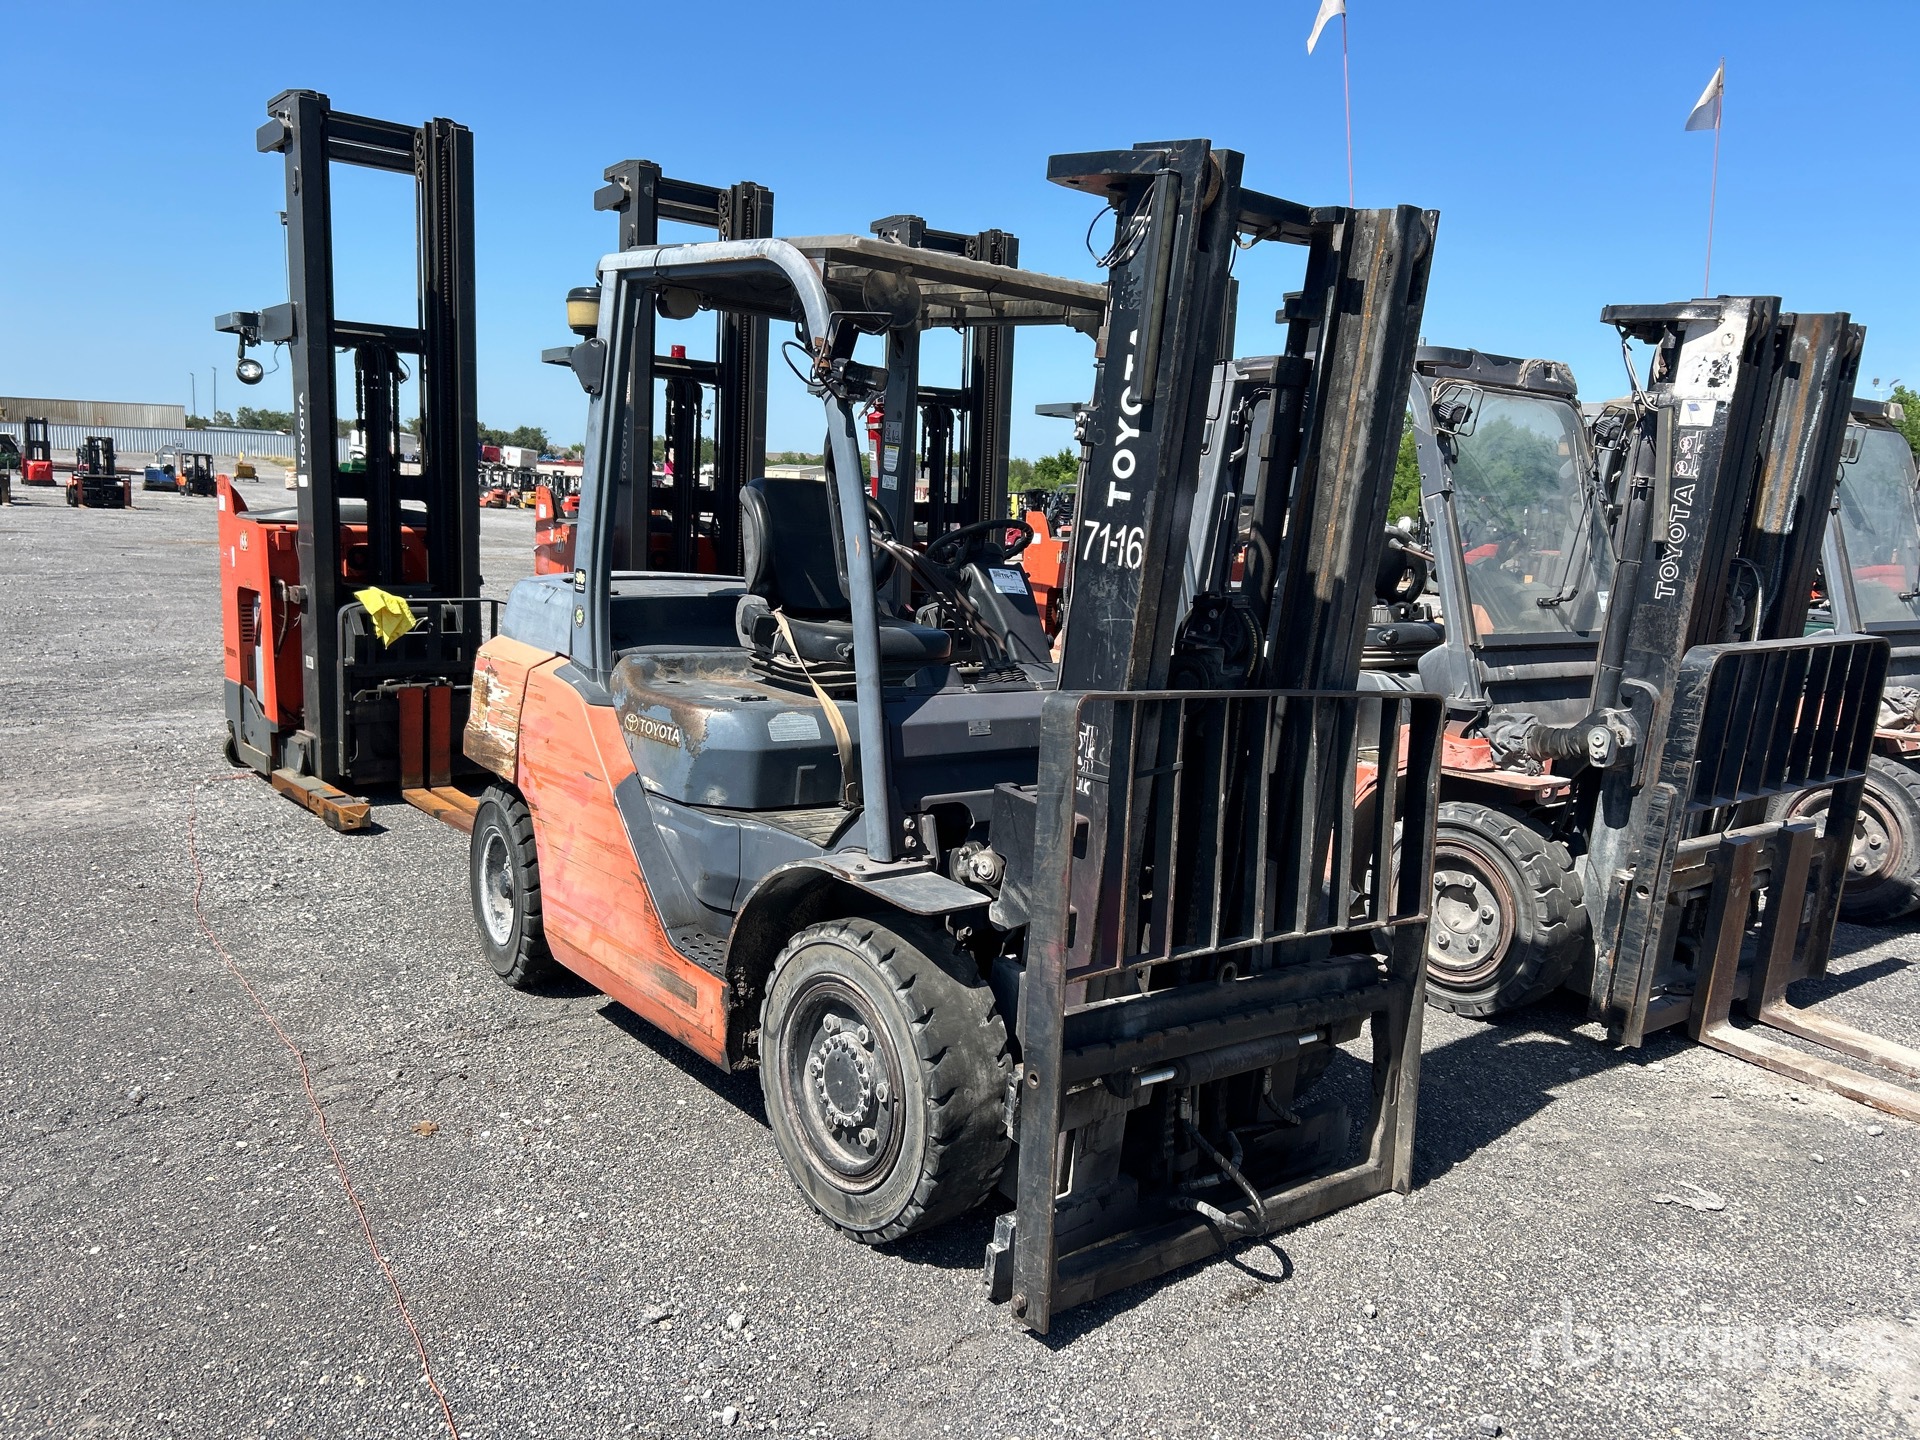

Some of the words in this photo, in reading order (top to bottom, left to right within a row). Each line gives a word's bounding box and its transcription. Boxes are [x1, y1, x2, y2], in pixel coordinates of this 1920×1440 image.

[298, 391, 307, 468] TOYOTA
[621, 416, 629, 482] TOYOTA
[1083, 519, 1145, 569] 71-16
[1654, 483, 1697, 600] TOYOTA
[639, 718, 681, 743] TOYOTA
